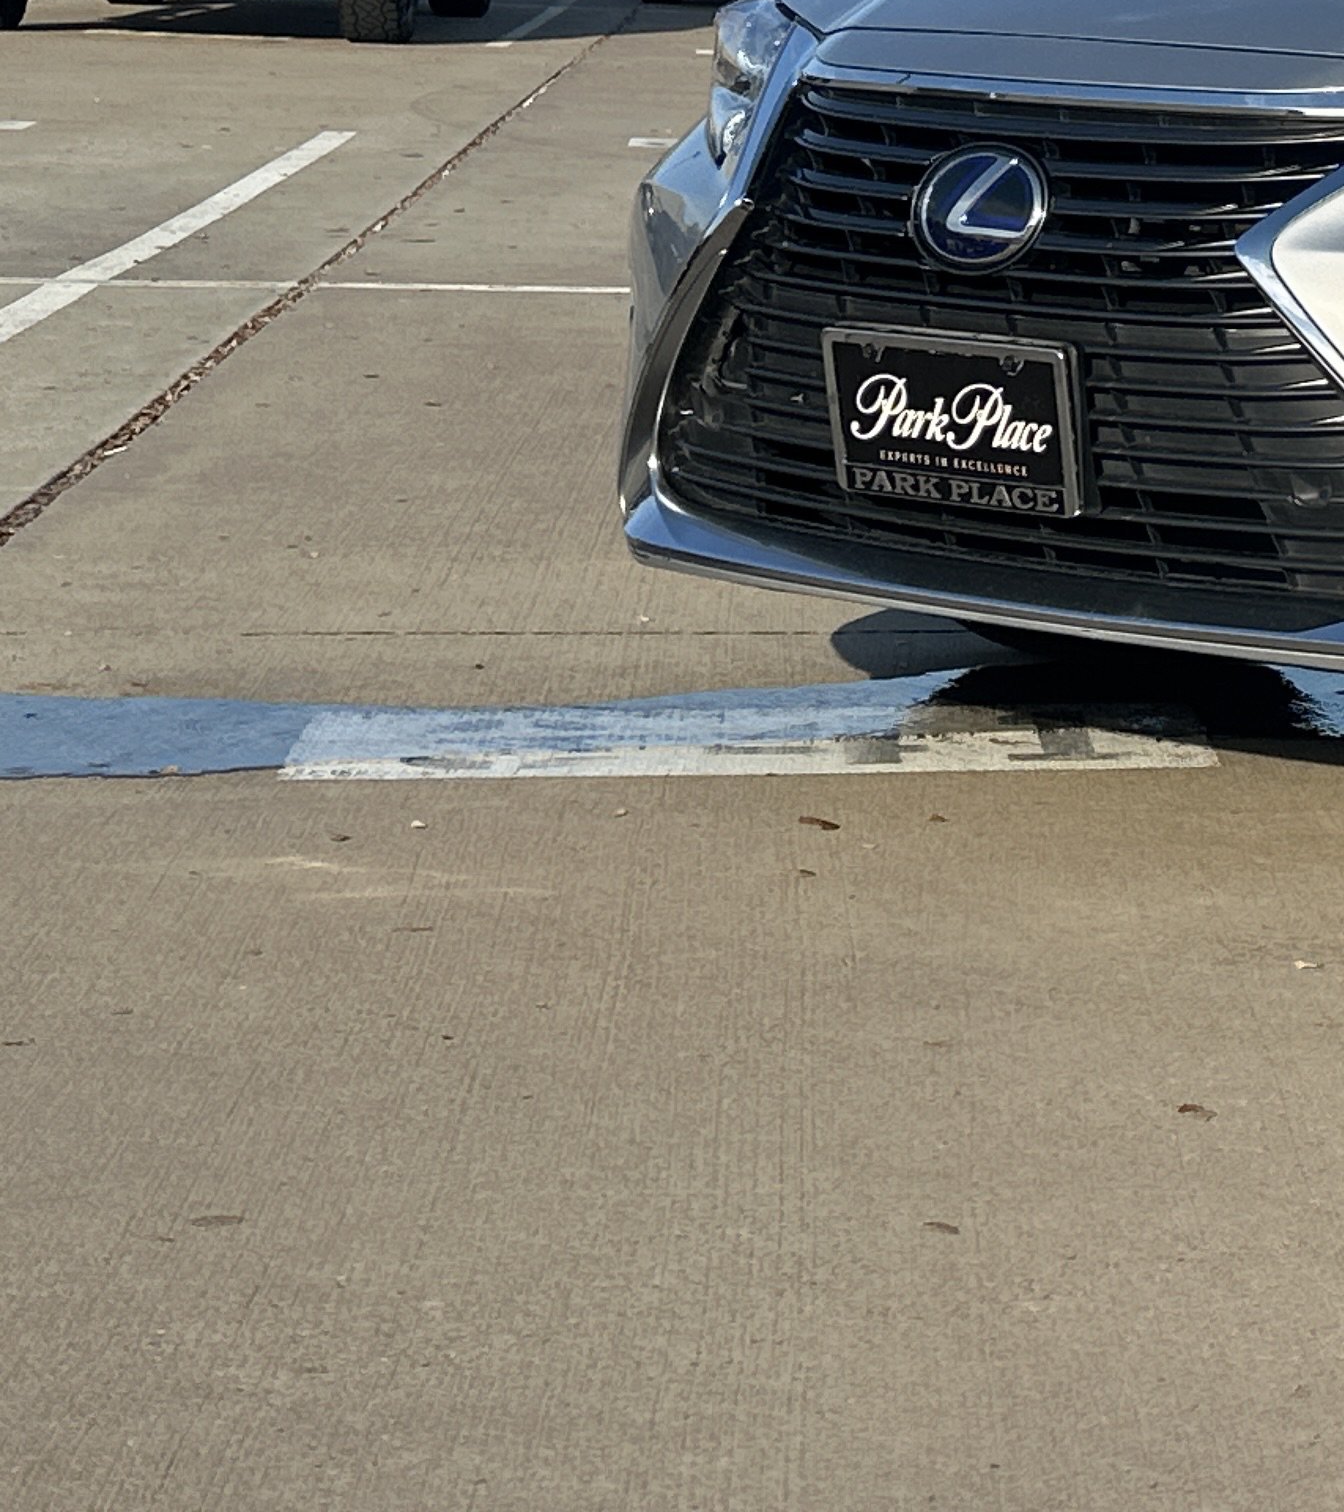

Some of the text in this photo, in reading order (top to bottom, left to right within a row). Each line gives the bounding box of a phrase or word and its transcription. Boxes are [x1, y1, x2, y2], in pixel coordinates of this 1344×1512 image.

[850, 373, 1053, 454] Park Place
[880, 449, 1029, 477] EXPERTS IN EXCELLENCE
[852, 468, 1060, 513] PARK PLACE
